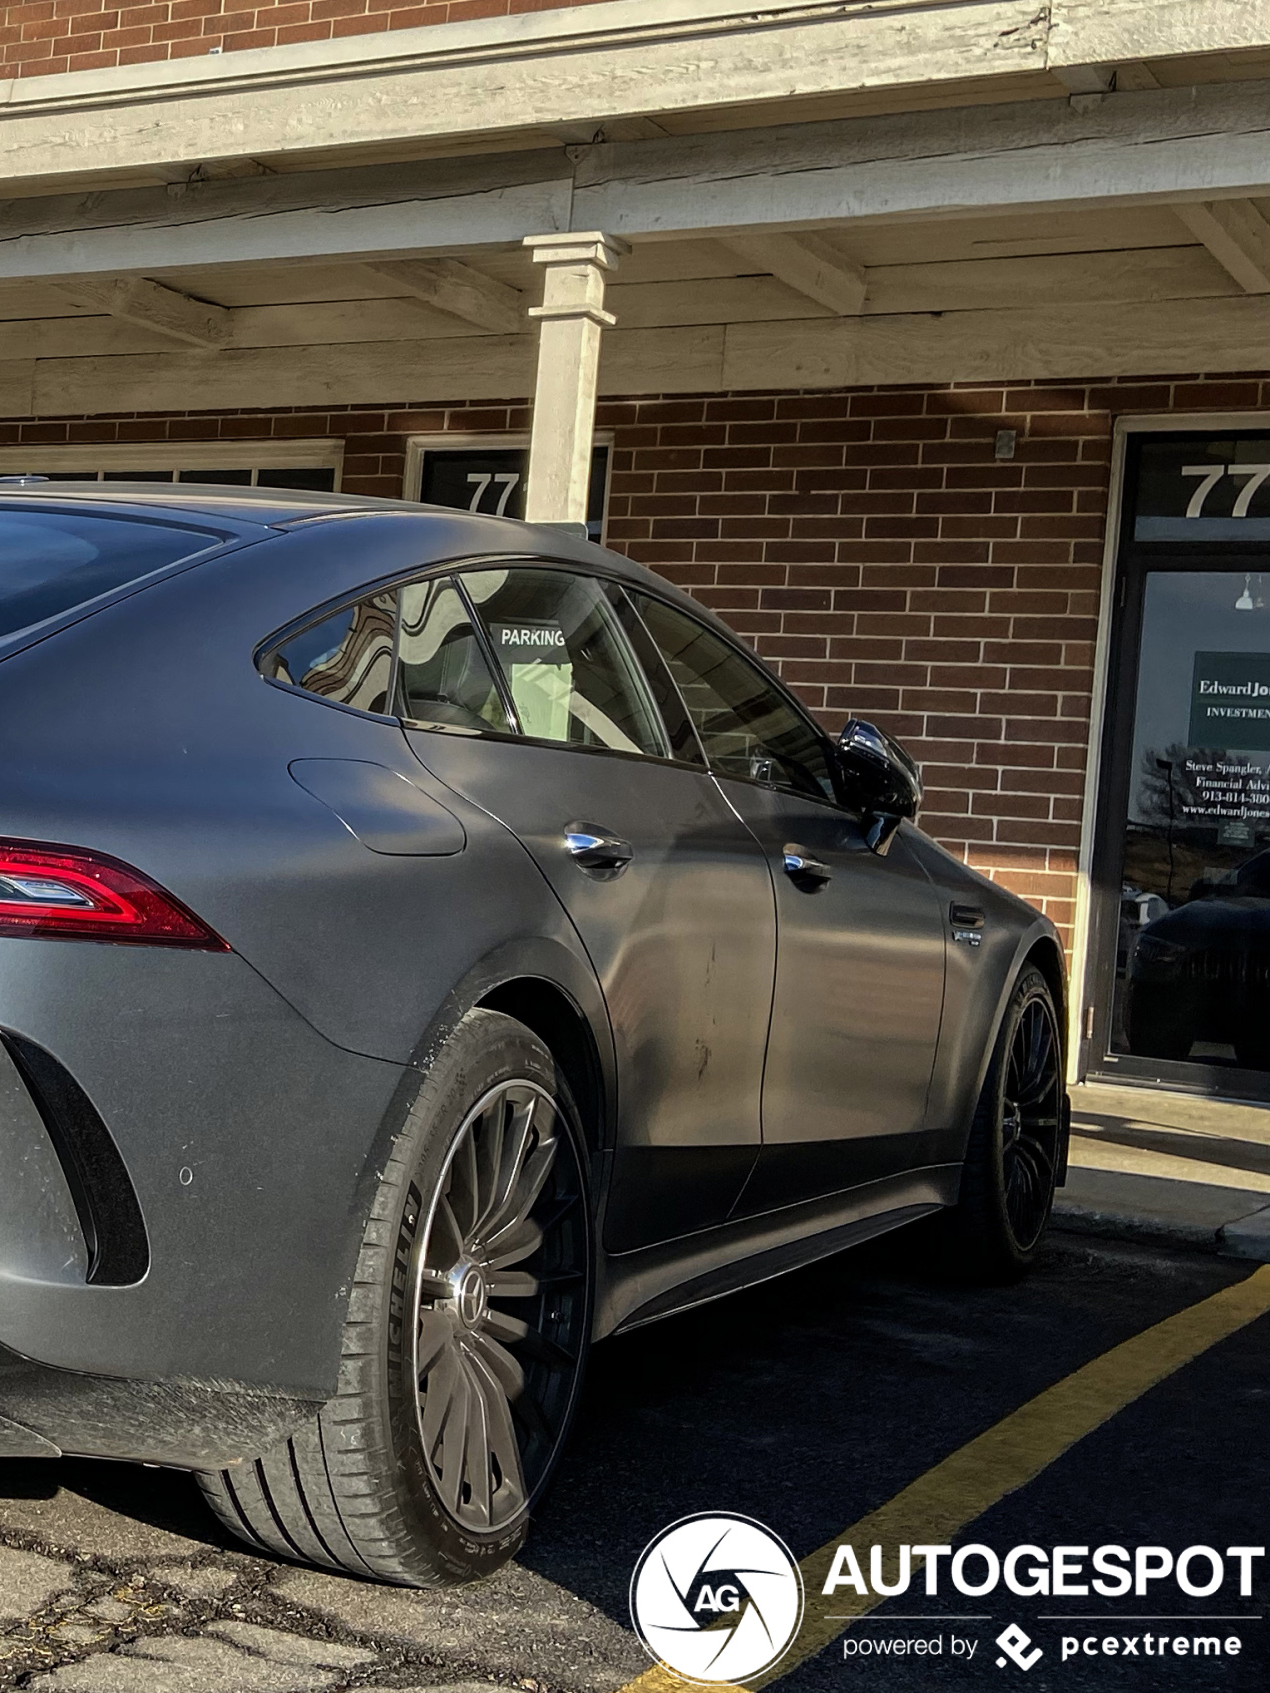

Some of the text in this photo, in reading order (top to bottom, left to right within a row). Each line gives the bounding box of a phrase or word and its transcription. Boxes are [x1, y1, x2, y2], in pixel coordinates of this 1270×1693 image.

[501, 629, 566, 647] PARKING
[1252, 682, 1270, 697] Jo
[1185, 760, 1214, 772] Steve
[1215, 761, 1263, 776] Spangler,
[1196, 776, 1243, 789] Financial
[389, 1182, 419, 1400] MICHELIN
